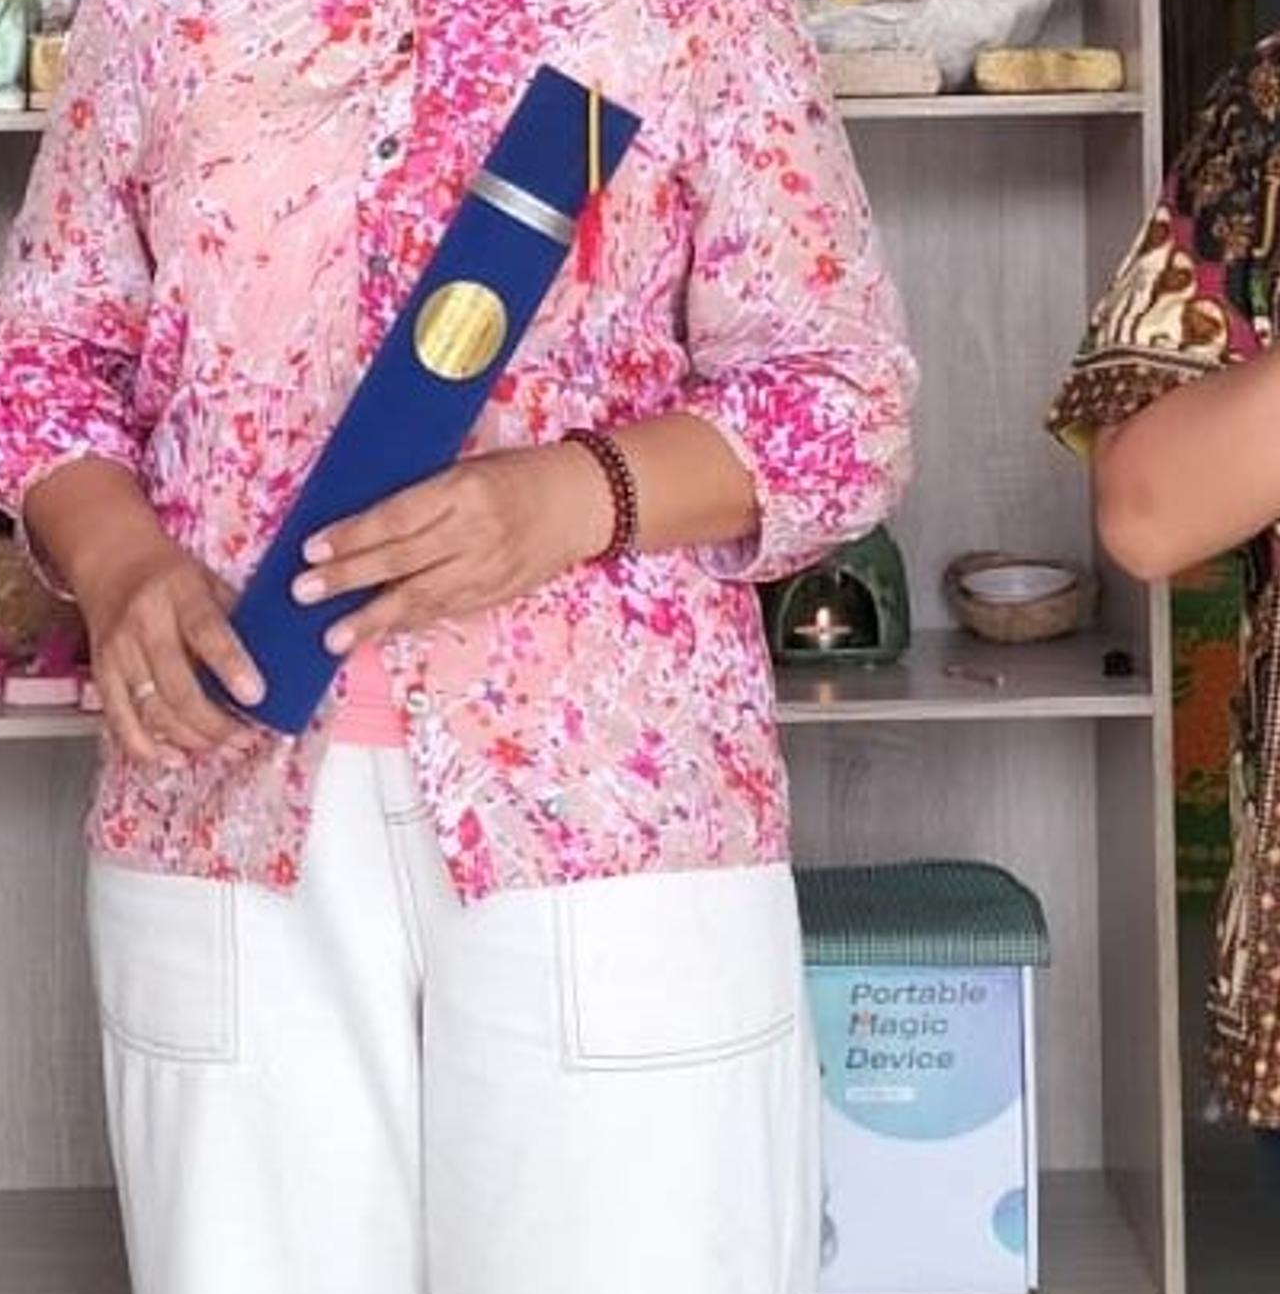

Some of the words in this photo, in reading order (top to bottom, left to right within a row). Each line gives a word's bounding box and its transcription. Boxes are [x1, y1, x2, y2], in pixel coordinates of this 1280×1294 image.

[850, 982, 988, 1006] Portable
[848, 1009, 949, 1041] Magic
[845, 1046, 956, 1070] Device
